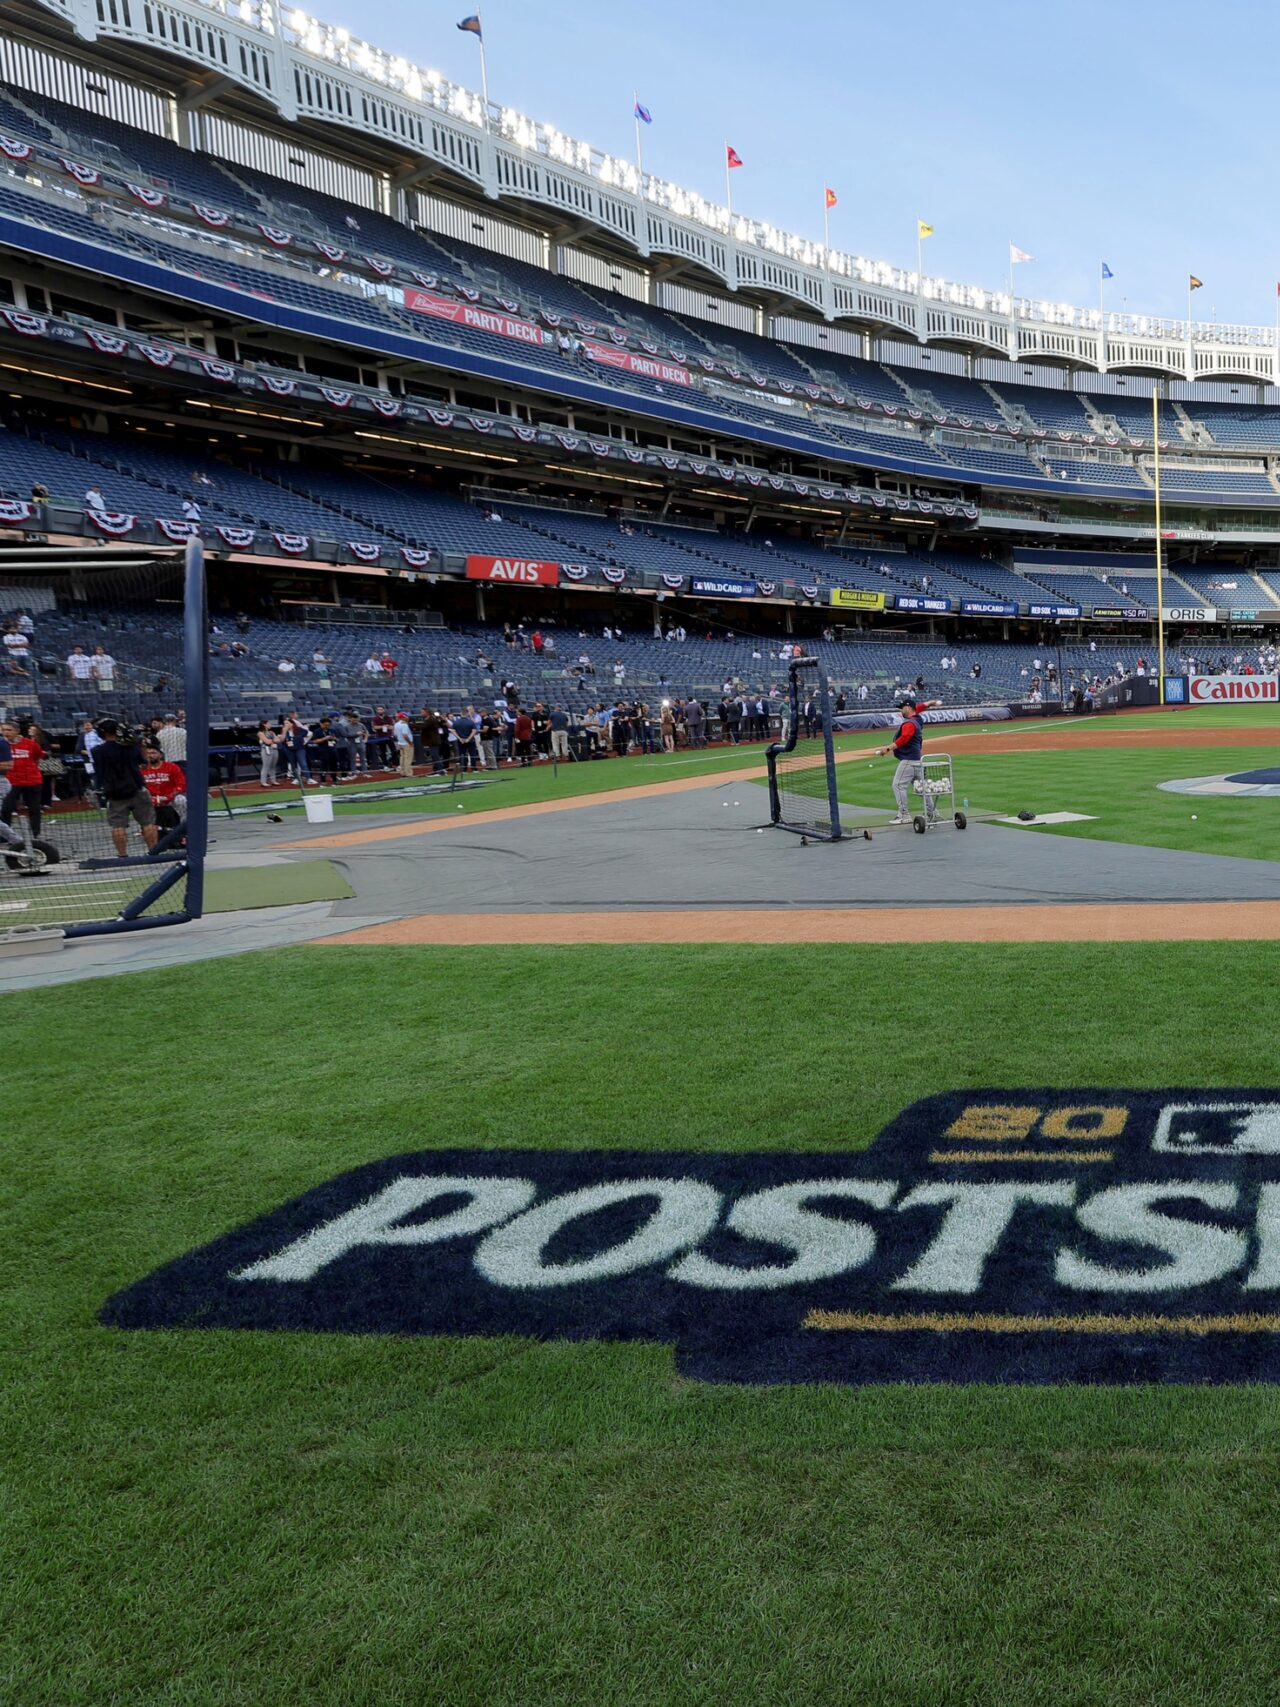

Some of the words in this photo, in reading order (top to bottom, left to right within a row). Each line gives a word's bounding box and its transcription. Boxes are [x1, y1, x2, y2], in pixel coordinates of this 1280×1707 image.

[464, 308, 503, 333] PARTY
[506, 321, 538, 343] DECK
[630, 357, 660, 376] PARTY
[662, 367, 686, 384] DECK
[489, 560, 539, 581] AVIS
[1170, 608, 1205, 620] ORIS
[1191, 678, 1276, 700] Canon
[944, 1104, 1129, 1140] 20
